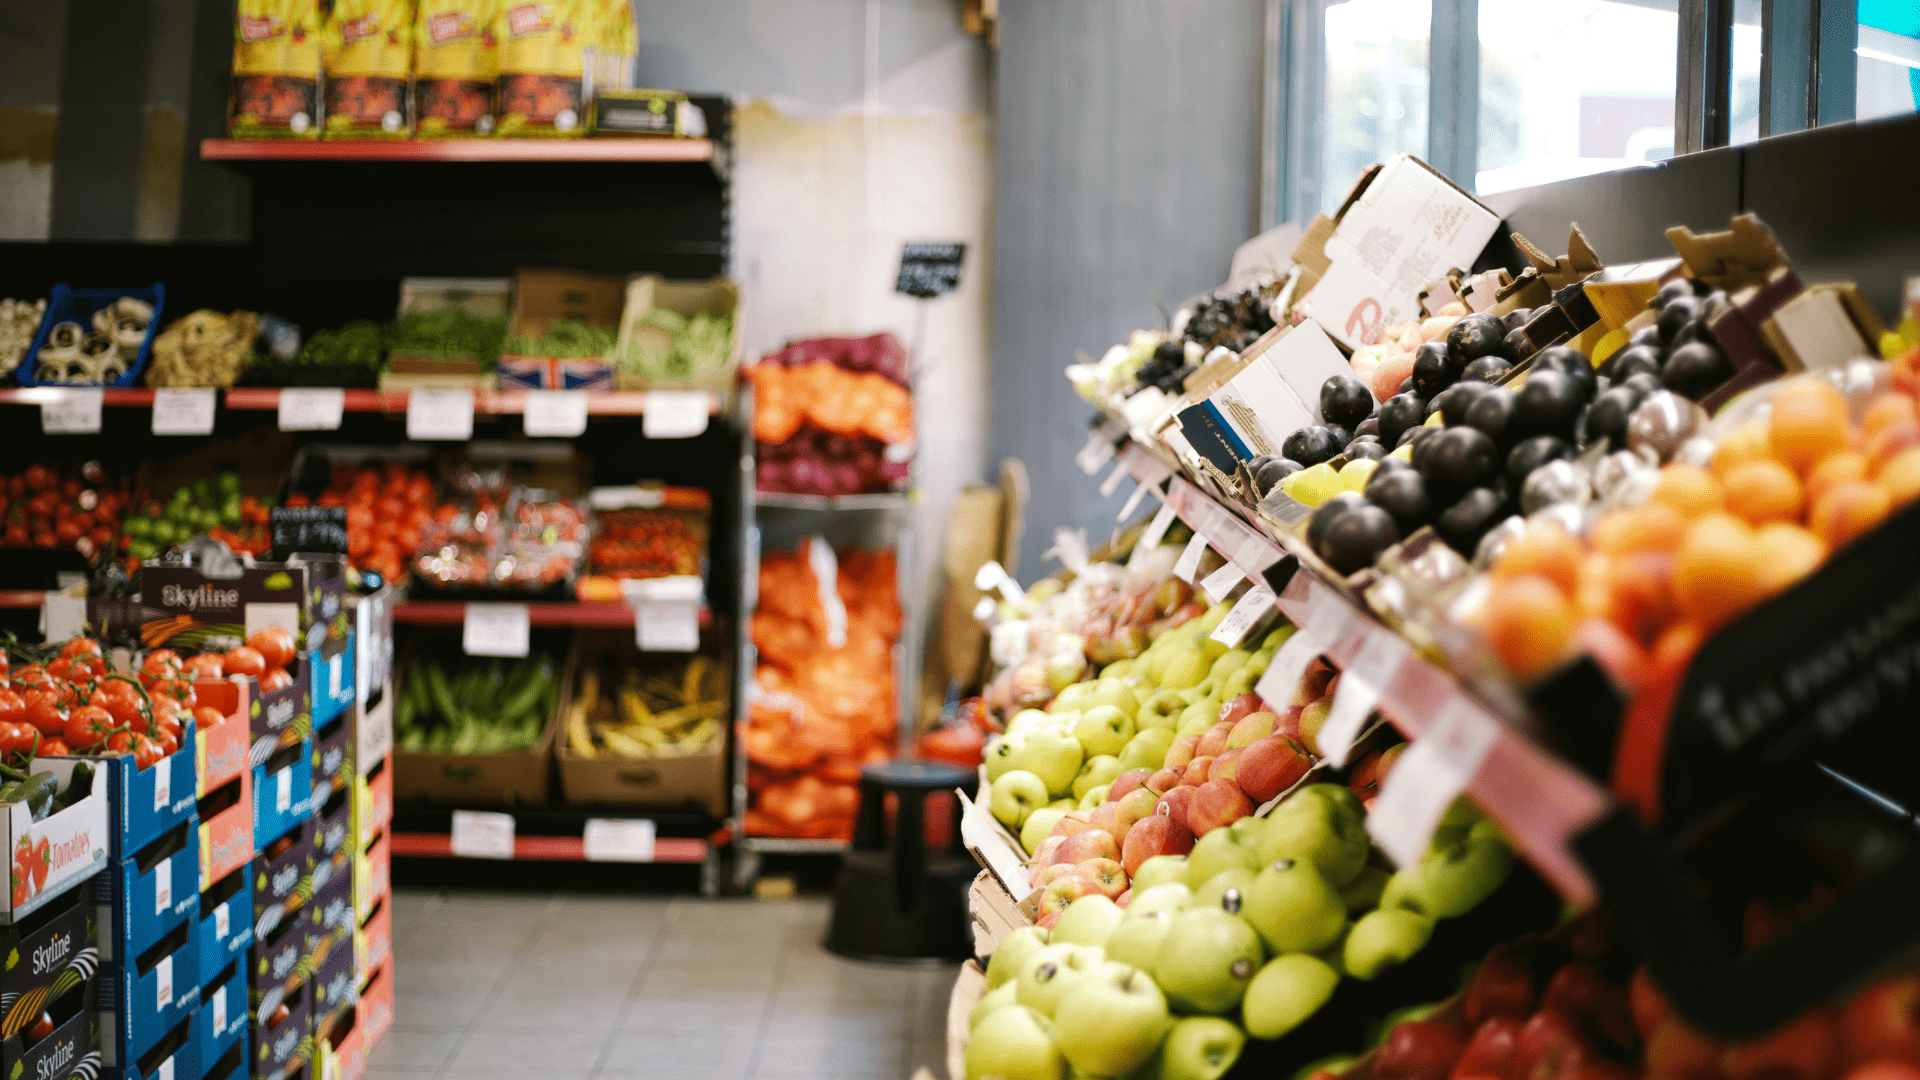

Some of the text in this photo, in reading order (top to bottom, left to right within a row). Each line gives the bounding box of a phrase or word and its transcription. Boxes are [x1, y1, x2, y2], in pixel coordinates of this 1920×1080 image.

[161, 583, 239, 612] Skyline
[32, 932, 71, 975] Skyline
[37, 1040, 74, 1080] Skyline
